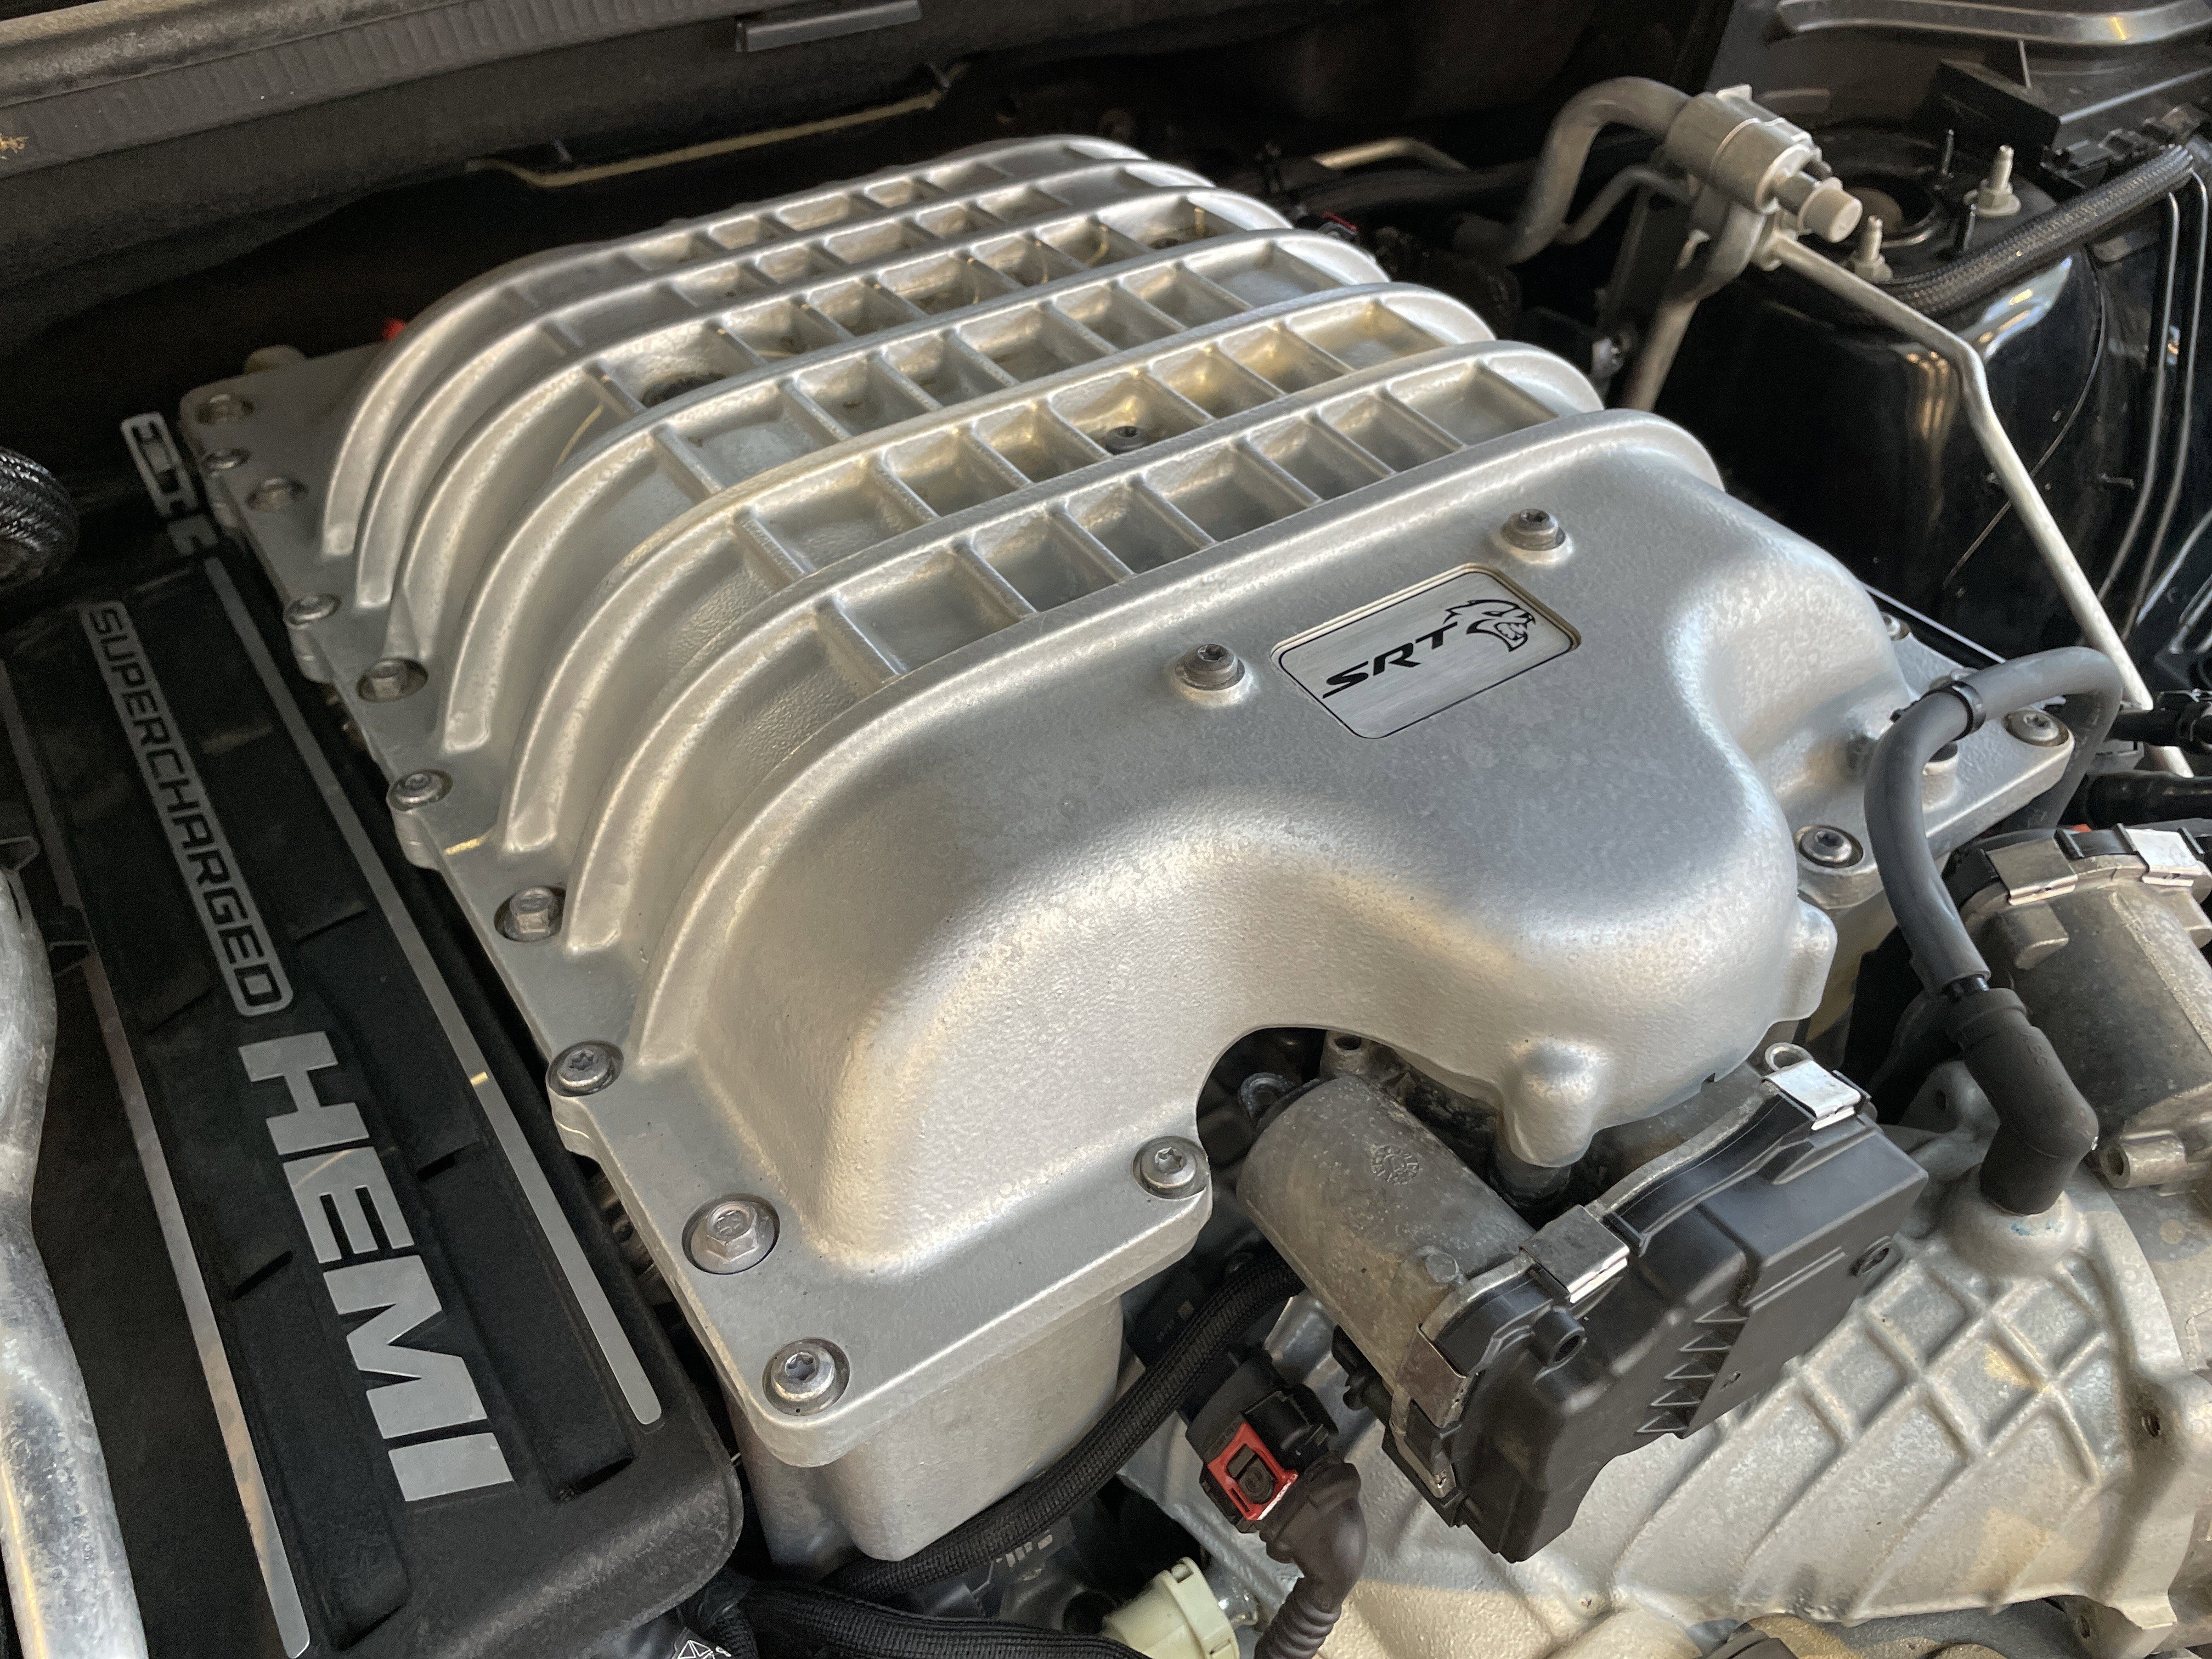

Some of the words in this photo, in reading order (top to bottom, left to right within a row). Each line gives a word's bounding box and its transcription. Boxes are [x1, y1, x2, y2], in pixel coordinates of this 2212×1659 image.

[1322, 622, 1458, 698] SRT
[88, 607, 280, 1006] SUPERCHARGED
[238, 1031, 514, 1502] HEMI
